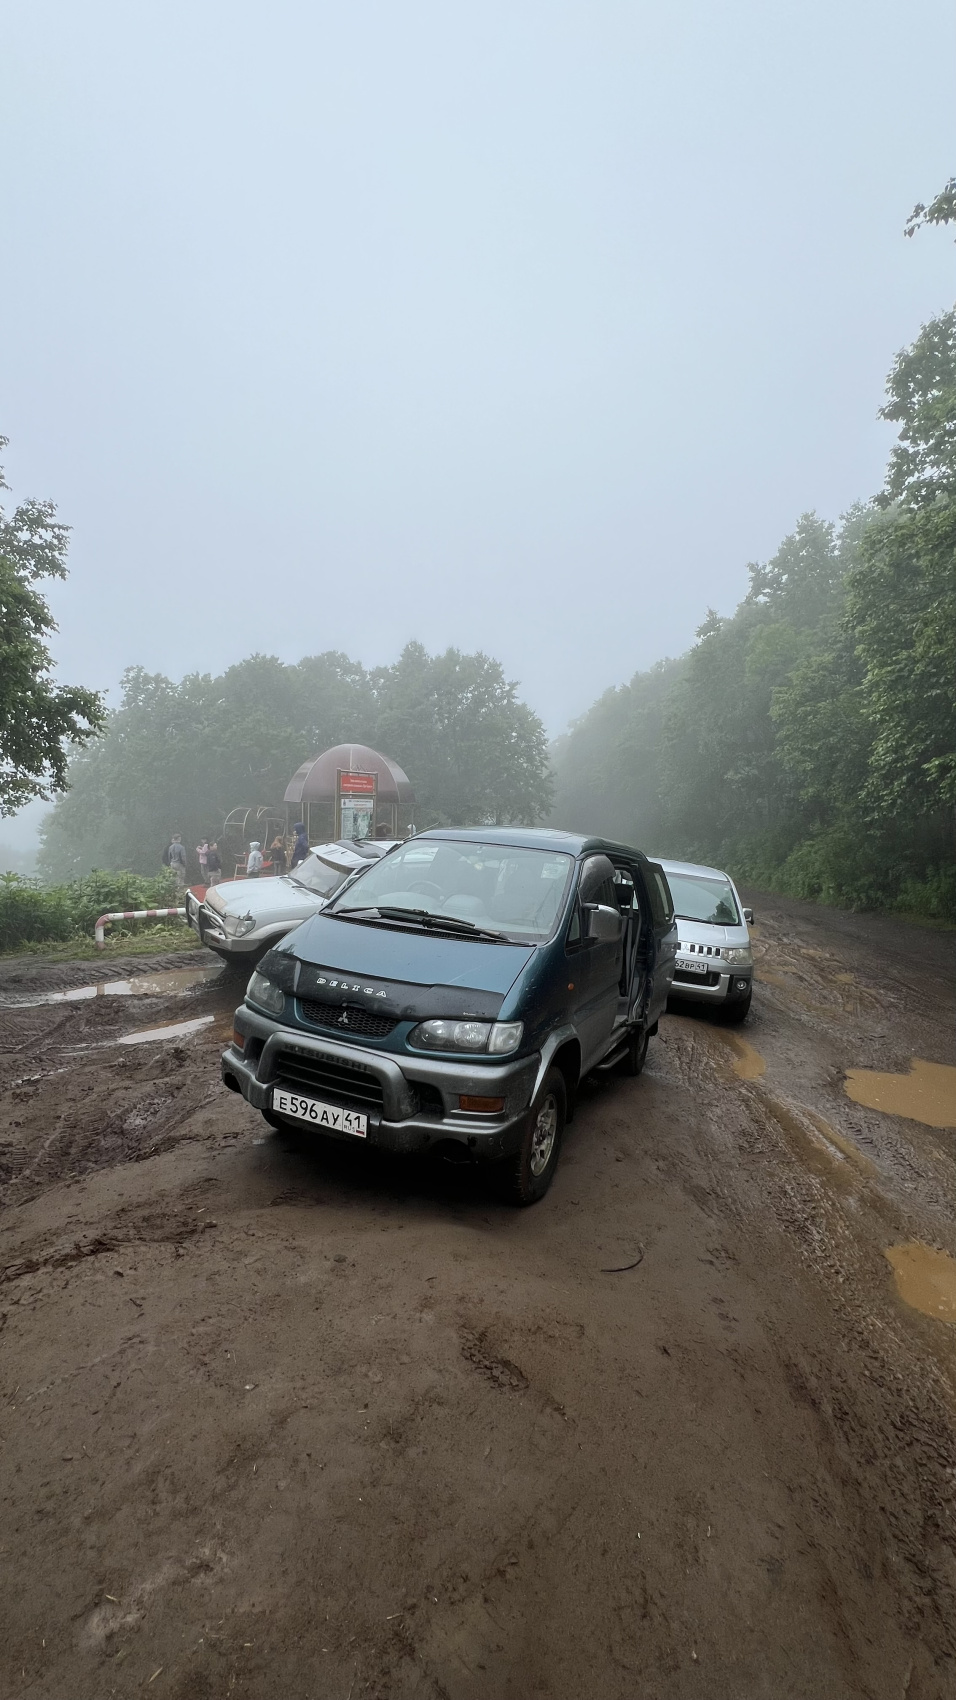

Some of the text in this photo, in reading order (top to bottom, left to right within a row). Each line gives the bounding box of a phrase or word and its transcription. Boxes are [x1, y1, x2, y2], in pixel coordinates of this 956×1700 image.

[316, 977, 387, 998] DELICA
[284, 1043, 369, 1073] MITSUBISHI
[343, 1124, 356, 1133] RUS
